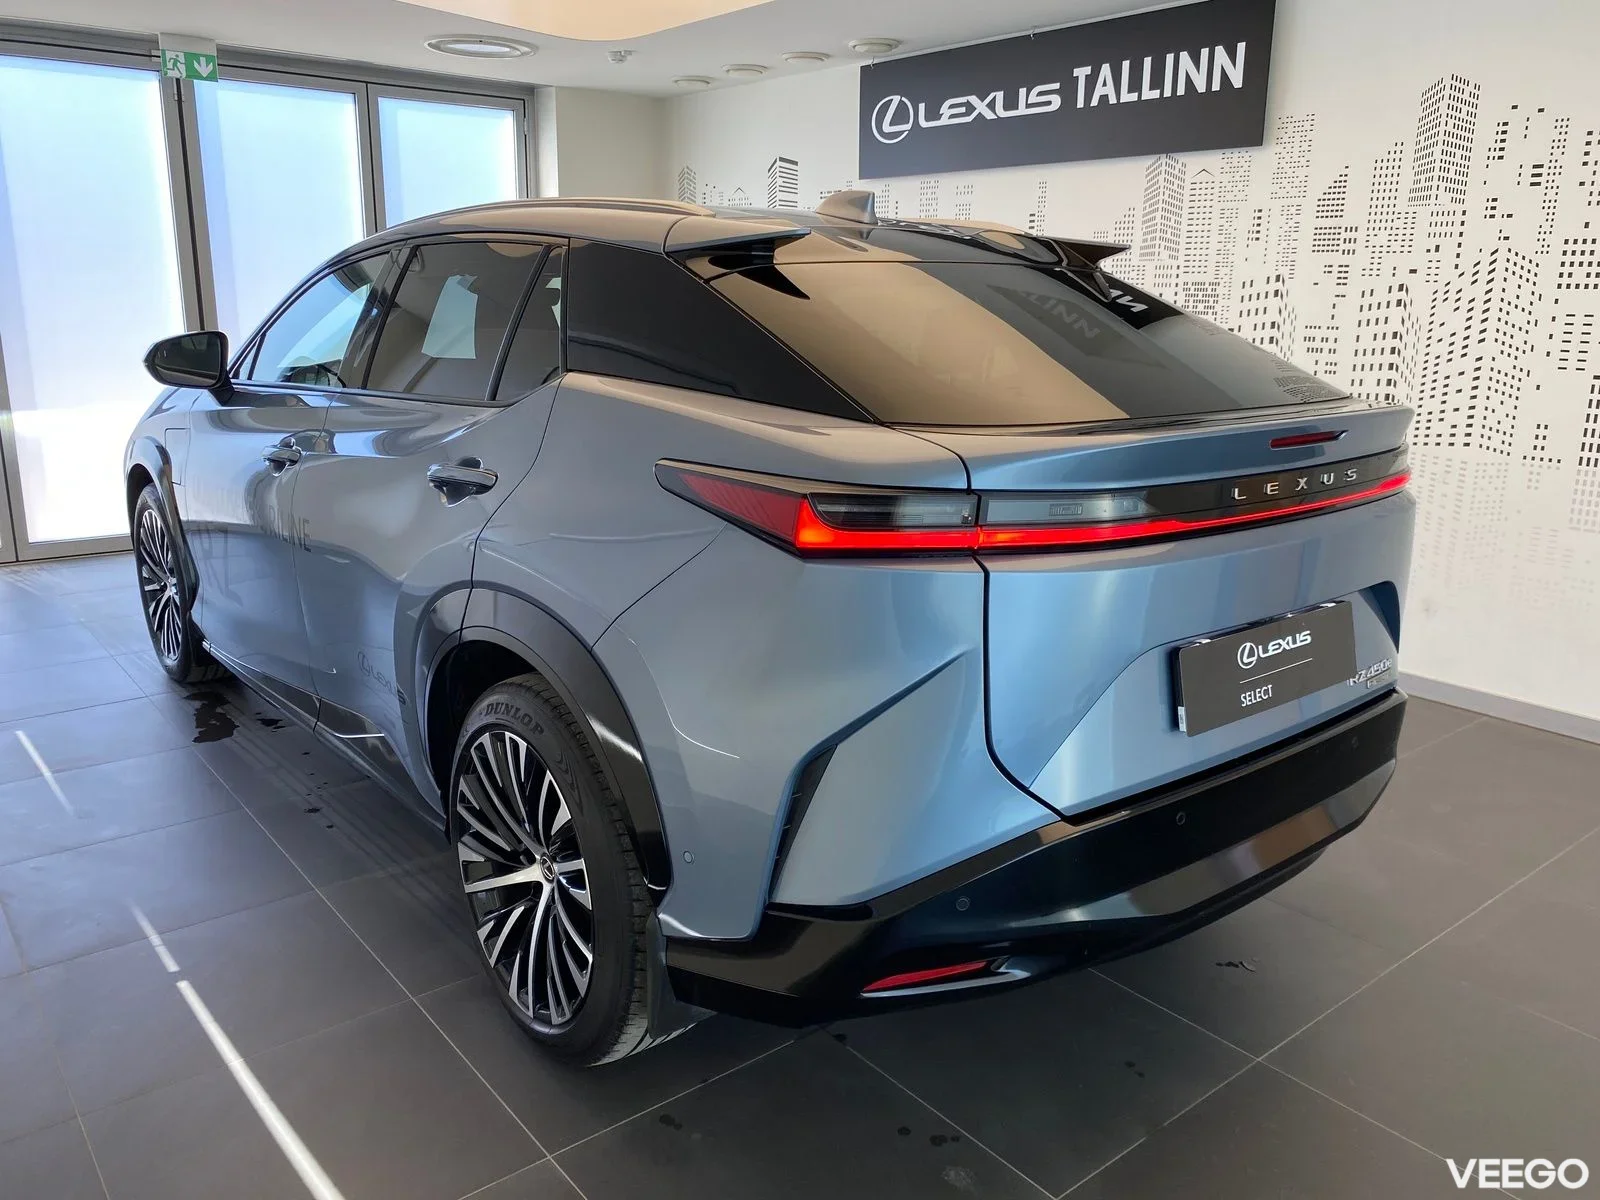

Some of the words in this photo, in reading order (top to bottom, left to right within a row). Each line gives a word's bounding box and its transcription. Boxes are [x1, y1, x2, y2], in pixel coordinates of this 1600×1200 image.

[917, 82, 1061, 129] LEXUS
[1073, 41, 1247, 109] TALLINN
[1231, 468, 1358, 500] LEXUS
[1258, 630, 1312, 659] LEXUS
[1240, 684, 1273, 707] SELECT
[484, 701, 545, 736] DUNLOP
